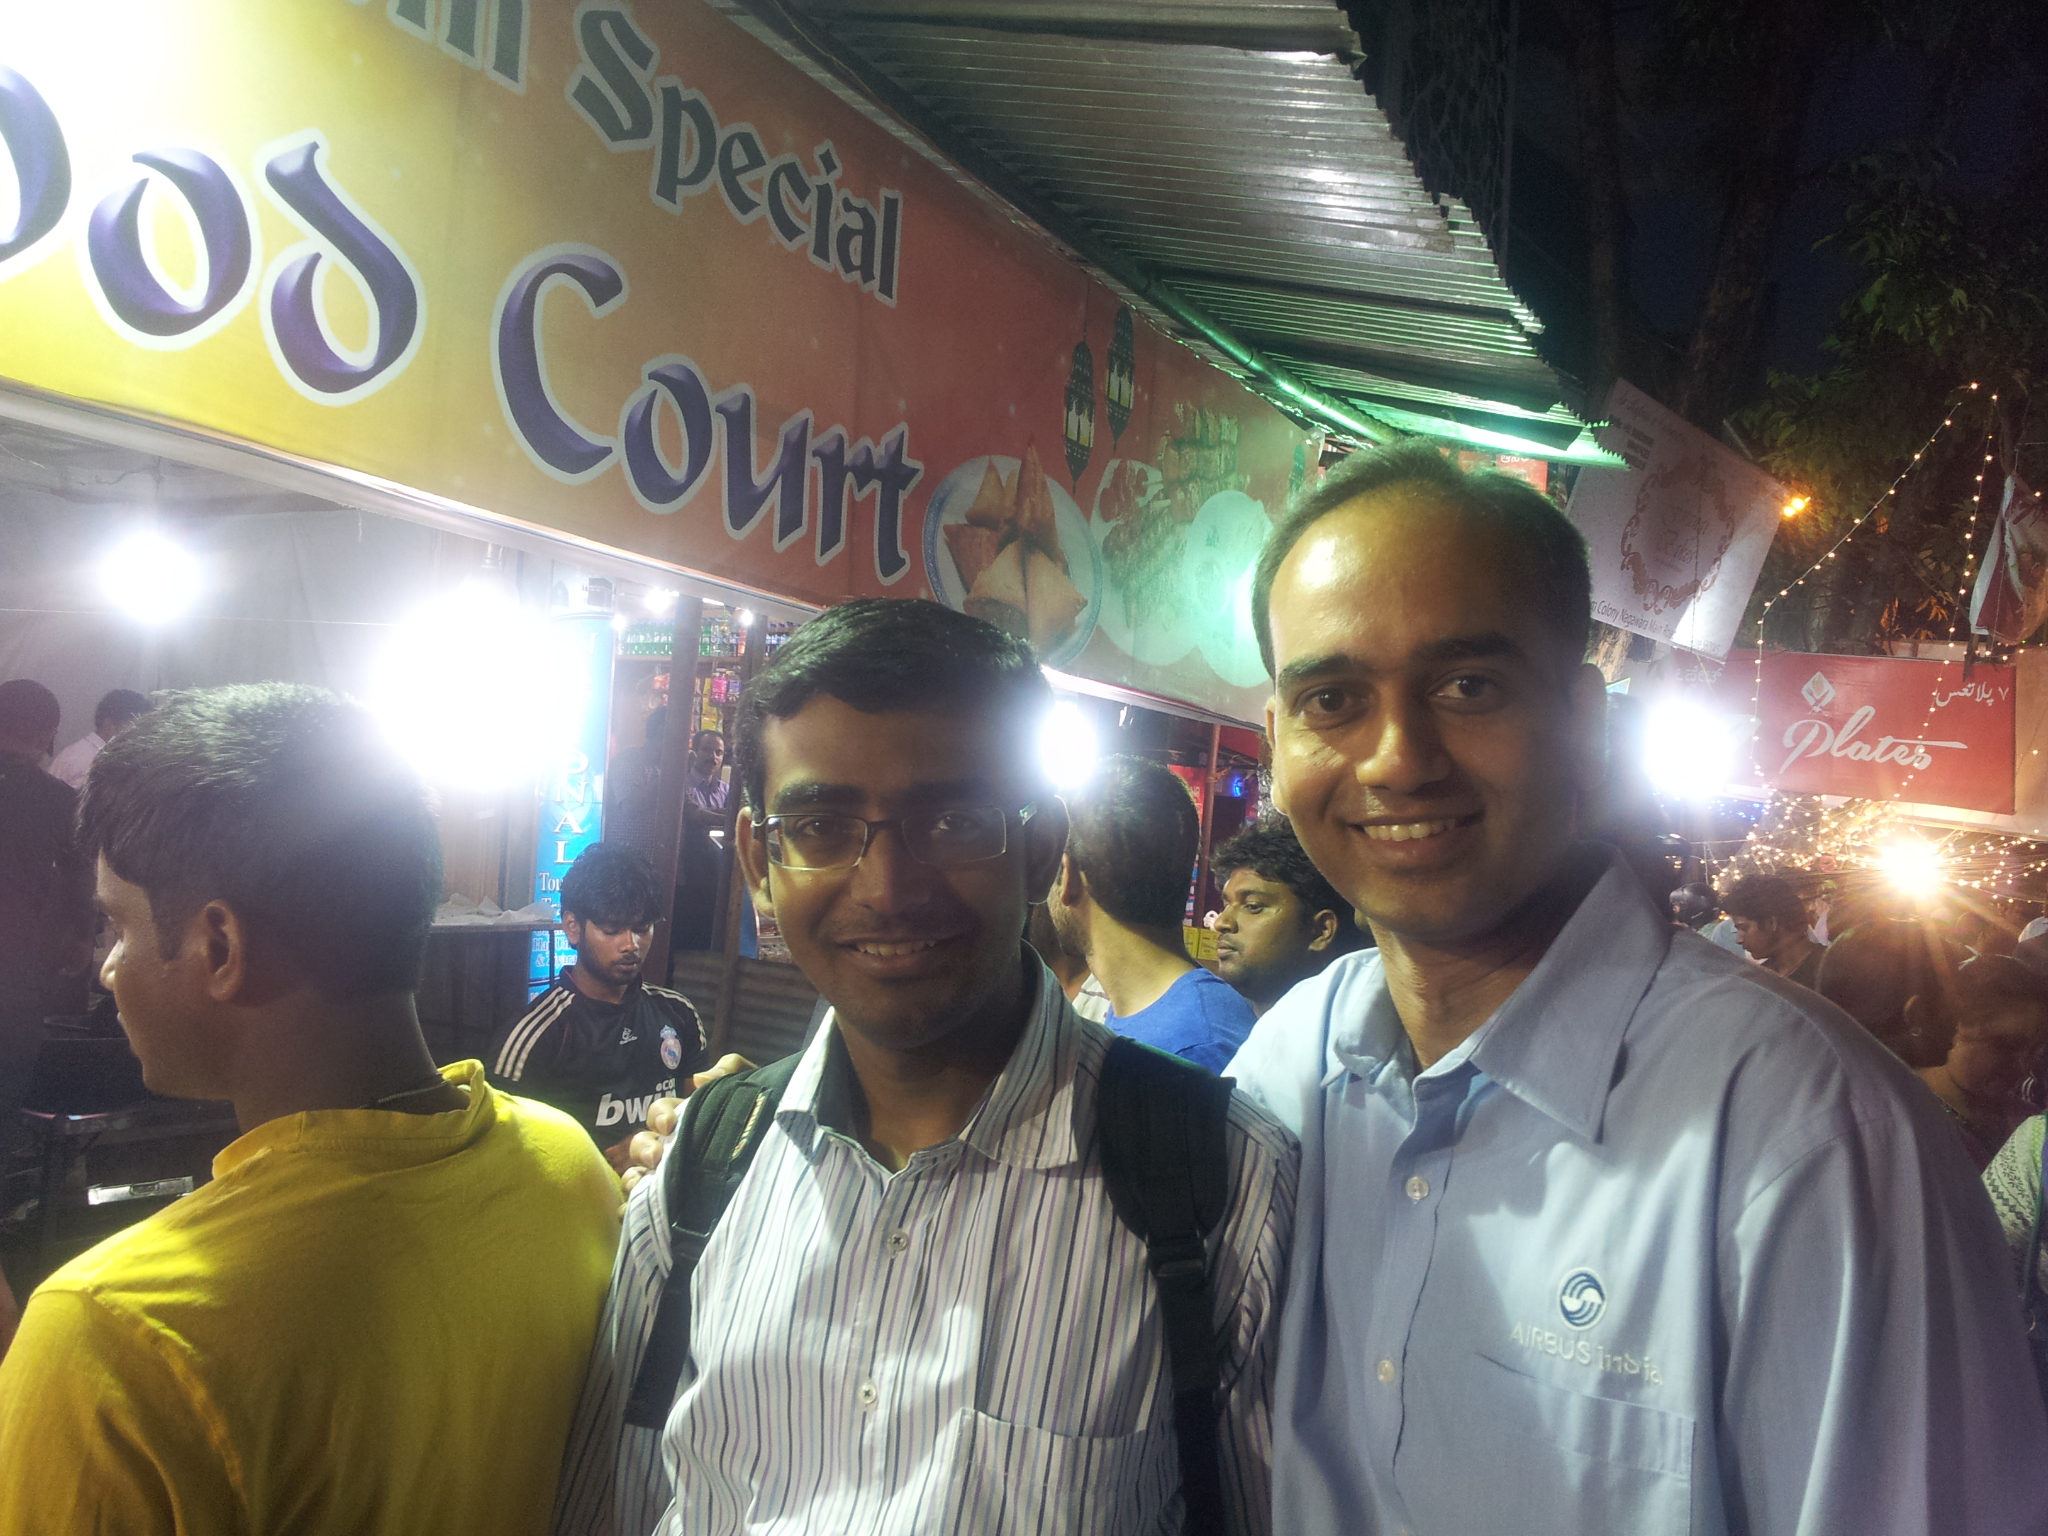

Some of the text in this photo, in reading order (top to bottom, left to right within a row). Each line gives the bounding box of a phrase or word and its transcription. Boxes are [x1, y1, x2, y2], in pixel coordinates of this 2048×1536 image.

[572, 10, 898, 299] Special
[499, 255, 920, 575] Court
[1597, 601, 1619, 622] Colony
[1779, 705, 1968, 775] Plates
[595, 1089, 677, 1126] bw
[1508, 1322, 1592, 1365] AIRBUS
